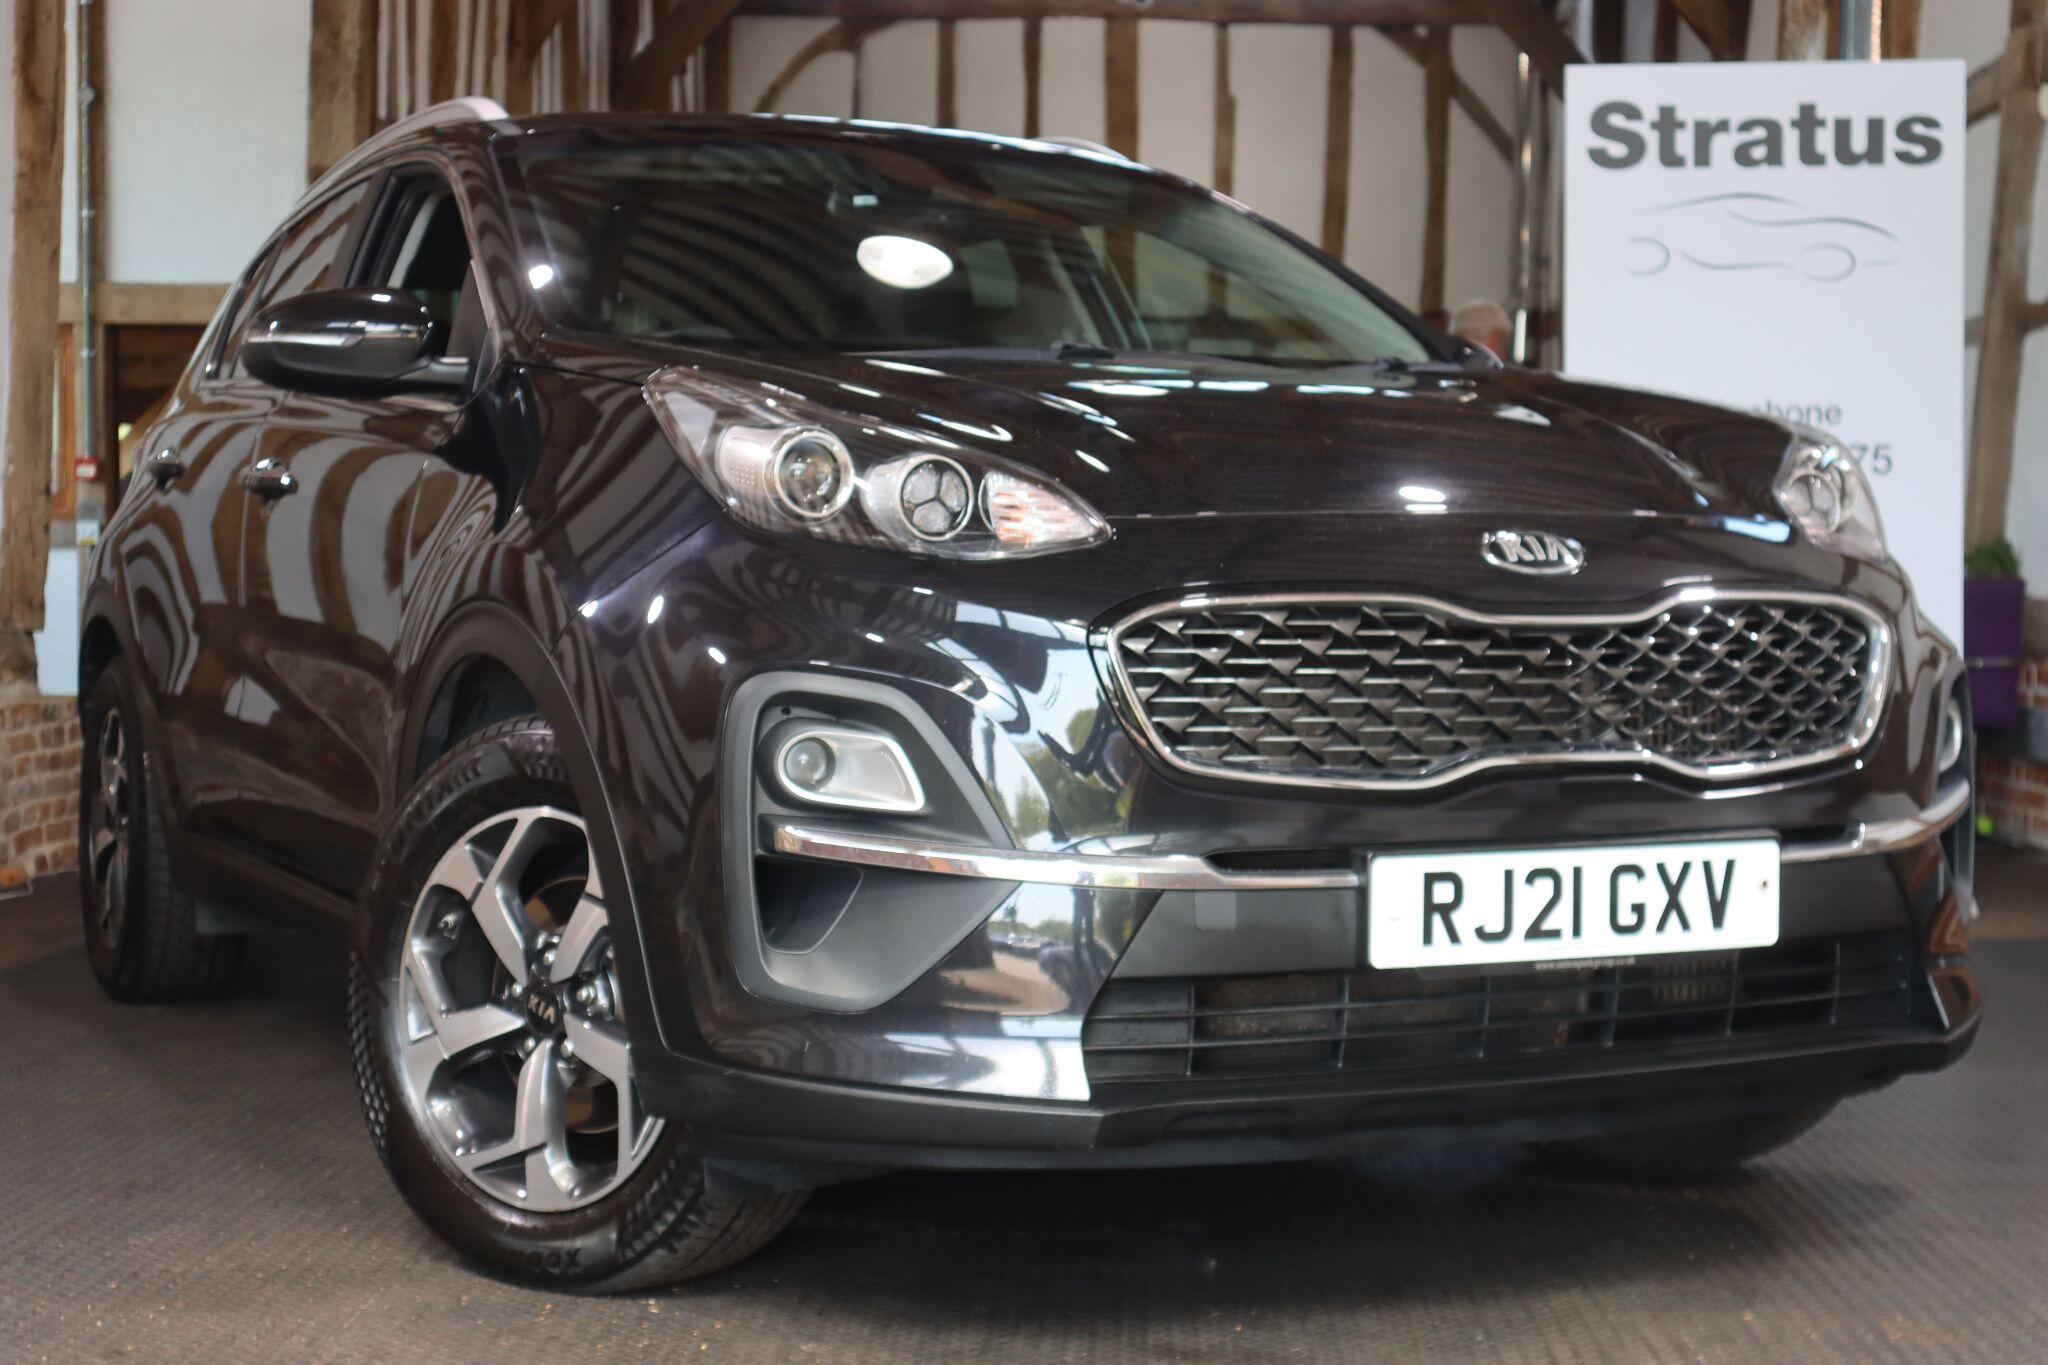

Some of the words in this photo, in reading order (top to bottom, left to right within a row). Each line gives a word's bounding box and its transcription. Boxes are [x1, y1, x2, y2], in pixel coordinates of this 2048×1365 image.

[1587, 101, 1944, 170] Stratus
[1495, 531, 1579, 567] KIA
[1422, 865, 1583, 947] RJ21
[1609, 858, 1736, 936] GXV
[527, 993, 556, 1024] KIA
